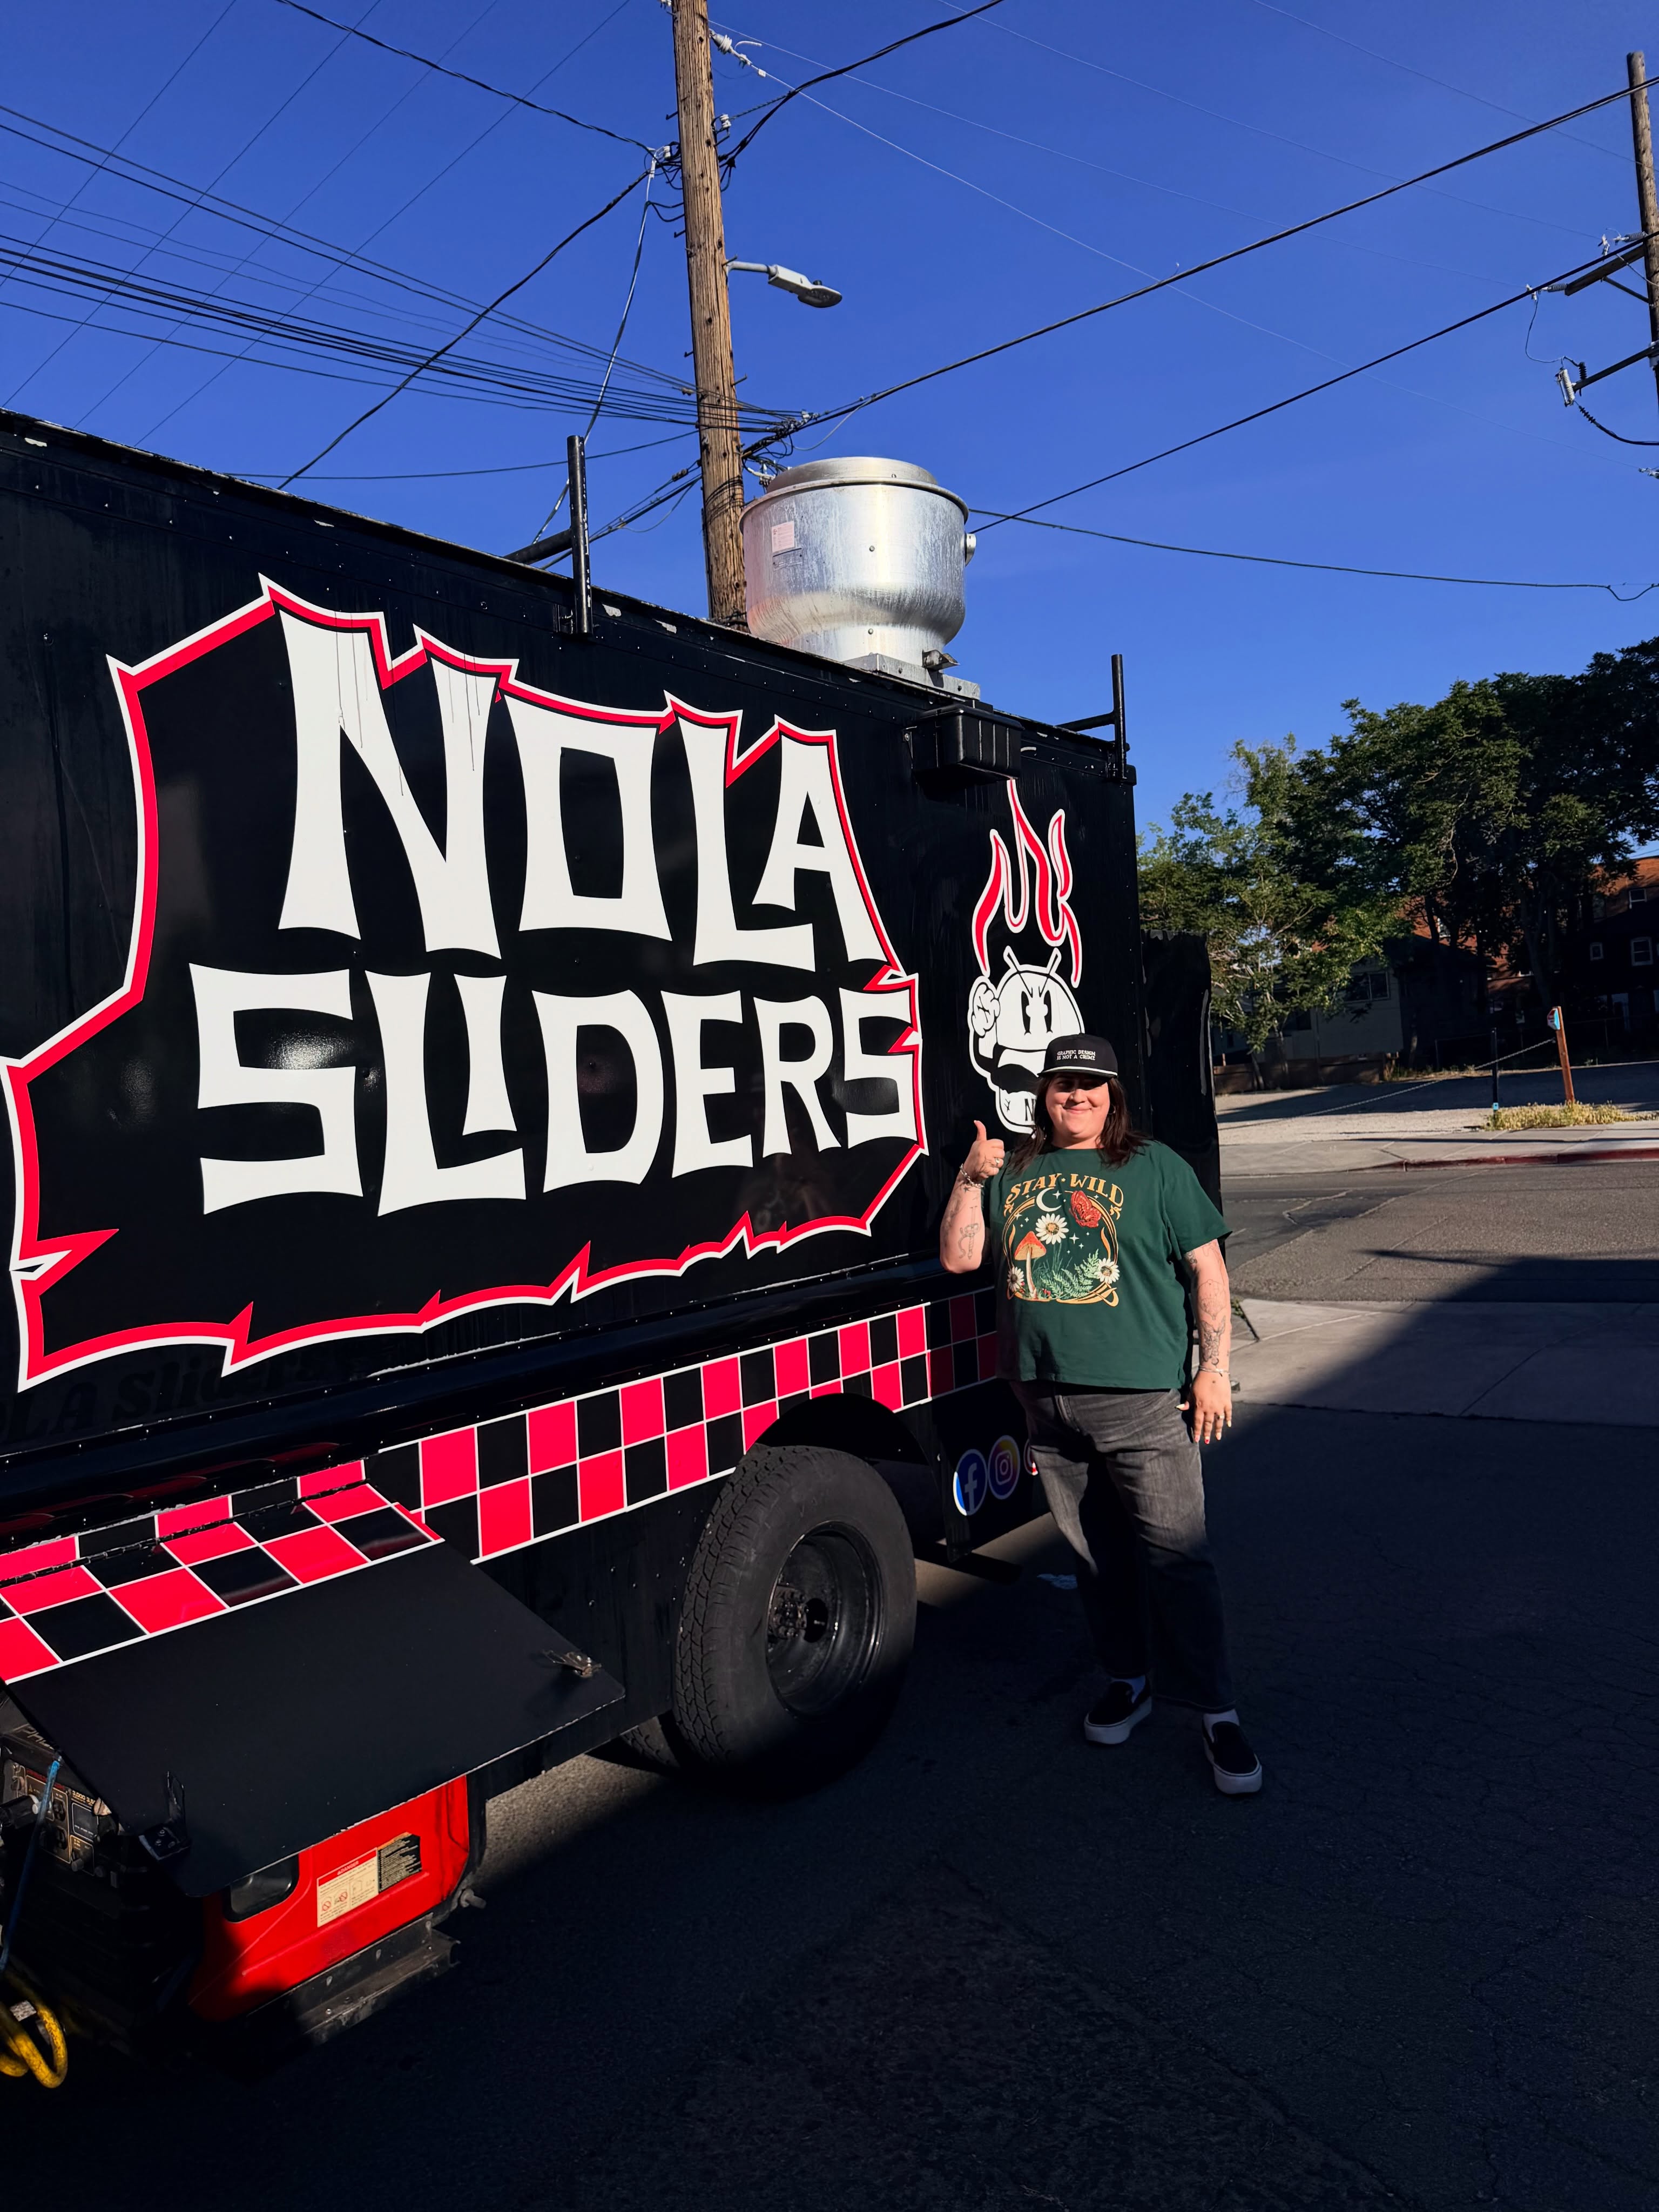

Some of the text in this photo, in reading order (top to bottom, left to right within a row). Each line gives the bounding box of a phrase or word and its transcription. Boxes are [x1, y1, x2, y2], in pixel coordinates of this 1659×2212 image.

[279, 611, 887, 970] NOLA
[188, 963, 918, 1216] SLIDERS
[1006, 1173, 1124, 1208] STAY WILD
